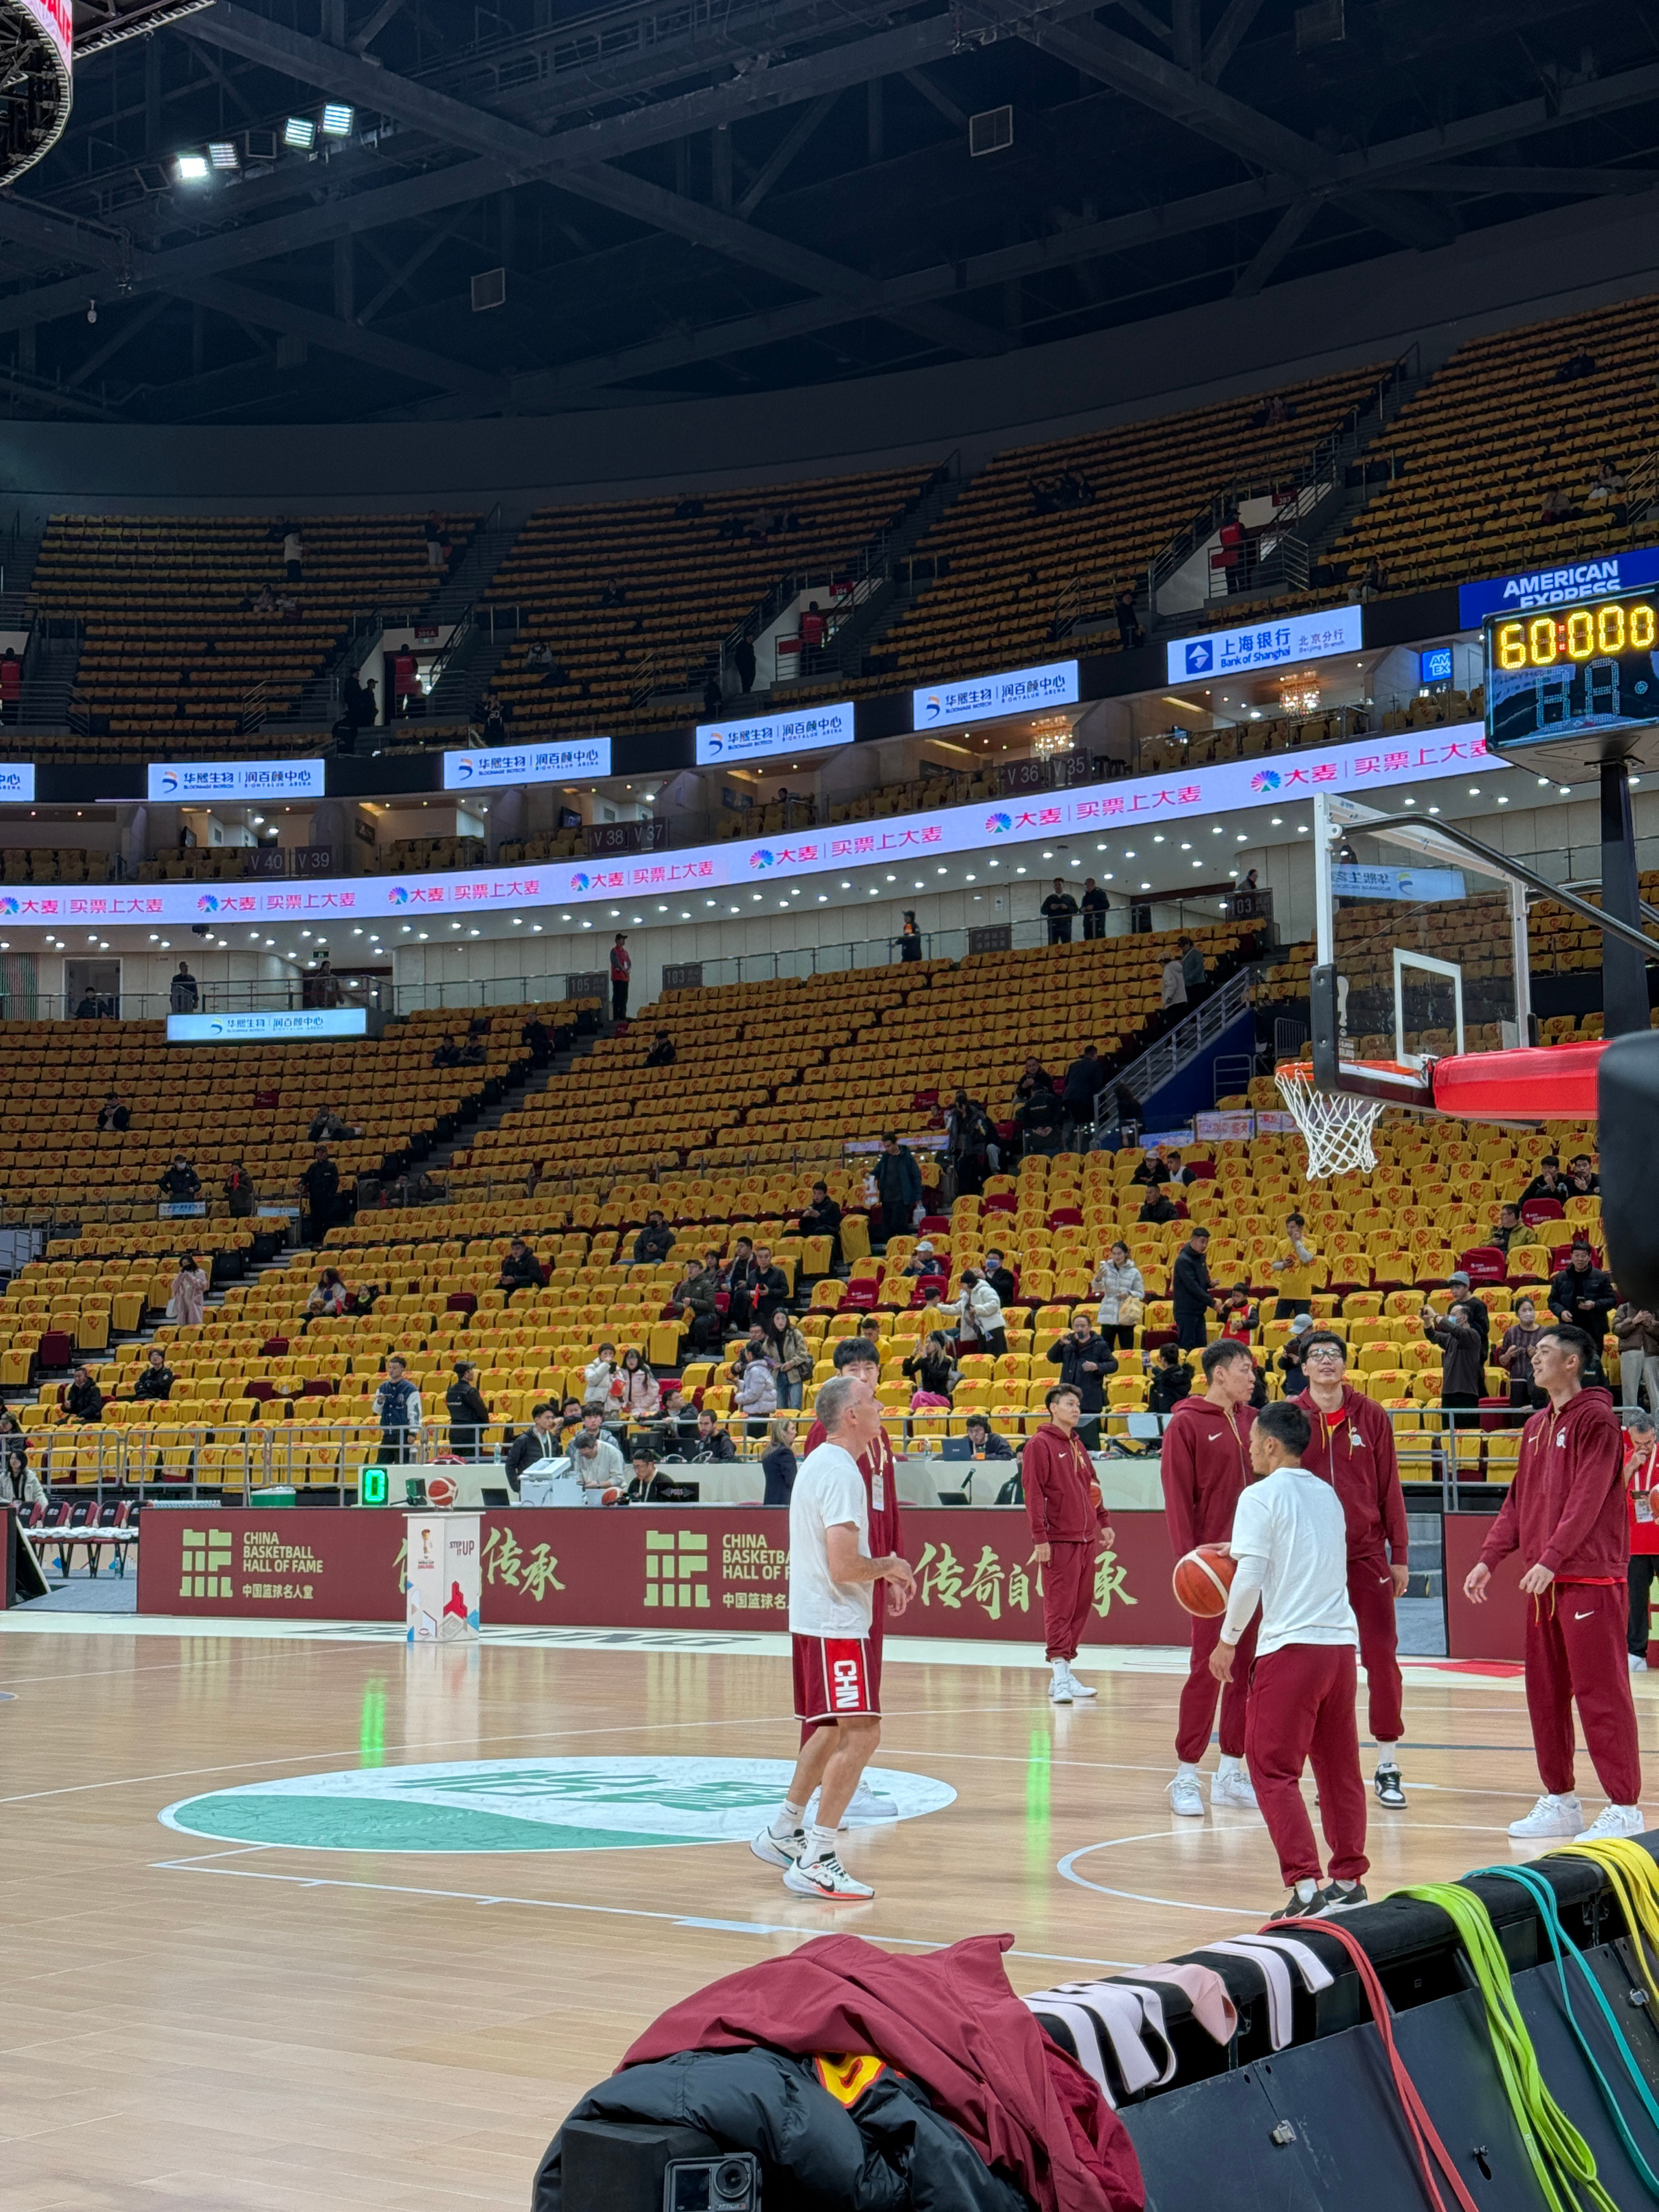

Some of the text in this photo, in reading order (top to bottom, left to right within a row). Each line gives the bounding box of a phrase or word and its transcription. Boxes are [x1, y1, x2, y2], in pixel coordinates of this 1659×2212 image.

[1503, 559, 1618, 599] AMERICAN
[1220, 628, 1344, 657] 上海银行 北京分行
[1221, 646, 1290, 668] Bank of Shanghai
[1002, 674, 1065, 698] 润百颜中心
[783, 716, 842, 736] 润百颜中心
[535, 749, 599, 765] 润百颜中心
[1284, 739, 1486, 787] 大麦 买票上大麦
[1007, 765, 1039, 785] V 36
[1053, 756, 1085, 777] V 35
[245, 770, 311, 783] 润百颜中心
[1015, 785, 1202, 829] 大麦 买票上大麦
[594, 829, 623, 847] V 38
[634, 825, 663, 842] V 37
[776, 826, 943, 865] 大麦 买票上大麦
[251, 854, 283, 870] V 40
[298, 852, 329, 868] V 39
[591, 861, 713, 889] 大麦 买票上大麦
[410, 880, 540, 903] 大麦 买票上大麦
[21, 898, 163, 915] 大麦 买票上大麦
[221, 893, 356, 911] 大麦 买票上大麦
[666, 969, 685, 984] 103
[244, 1532, 279, 1545] CHINA
[462, 1540, 475, 1555] UP
[723, 1534, 768, 1548] CHINA
[243, 1546, 314, 1559] BASKETBALL
[243, 1559, 323, 1573] HALL OF FAME
[723, 1565, 759, 1579] HALL
[762, 1565, 781, 1580] OF
[242, 1584, 313, 1599] 中国篮球名人堂
[833, 1660, 860, 1709] CHN
